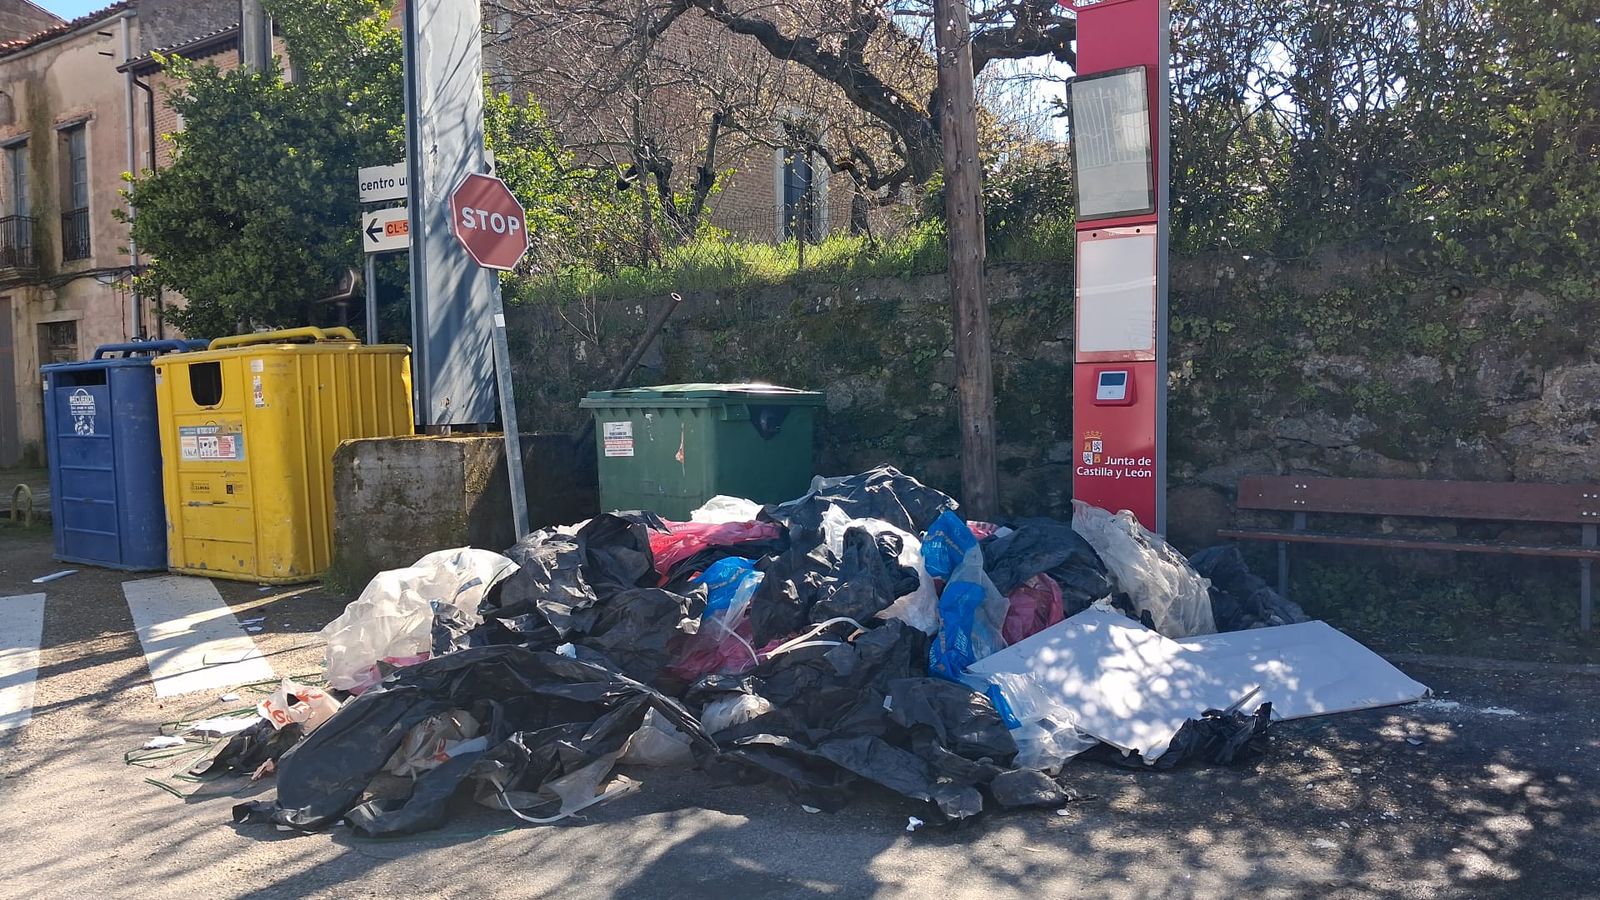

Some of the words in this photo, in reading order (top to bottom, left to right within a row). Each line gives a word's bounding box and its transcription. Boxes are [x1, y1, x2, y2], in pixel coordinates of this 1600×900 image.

[361, 177, 395, 191] centro
[461, 207, 520, 236] STOP
[387, 222, 409, 234] CL-5
[1105, 456, 1135, 466] Junta
[1137, 457, 1151, 466] de
[1076, 467, 1113, 477] Castilla
[1115, 470, 1122, 479] y
[1125, 467, 1152, 478] León
